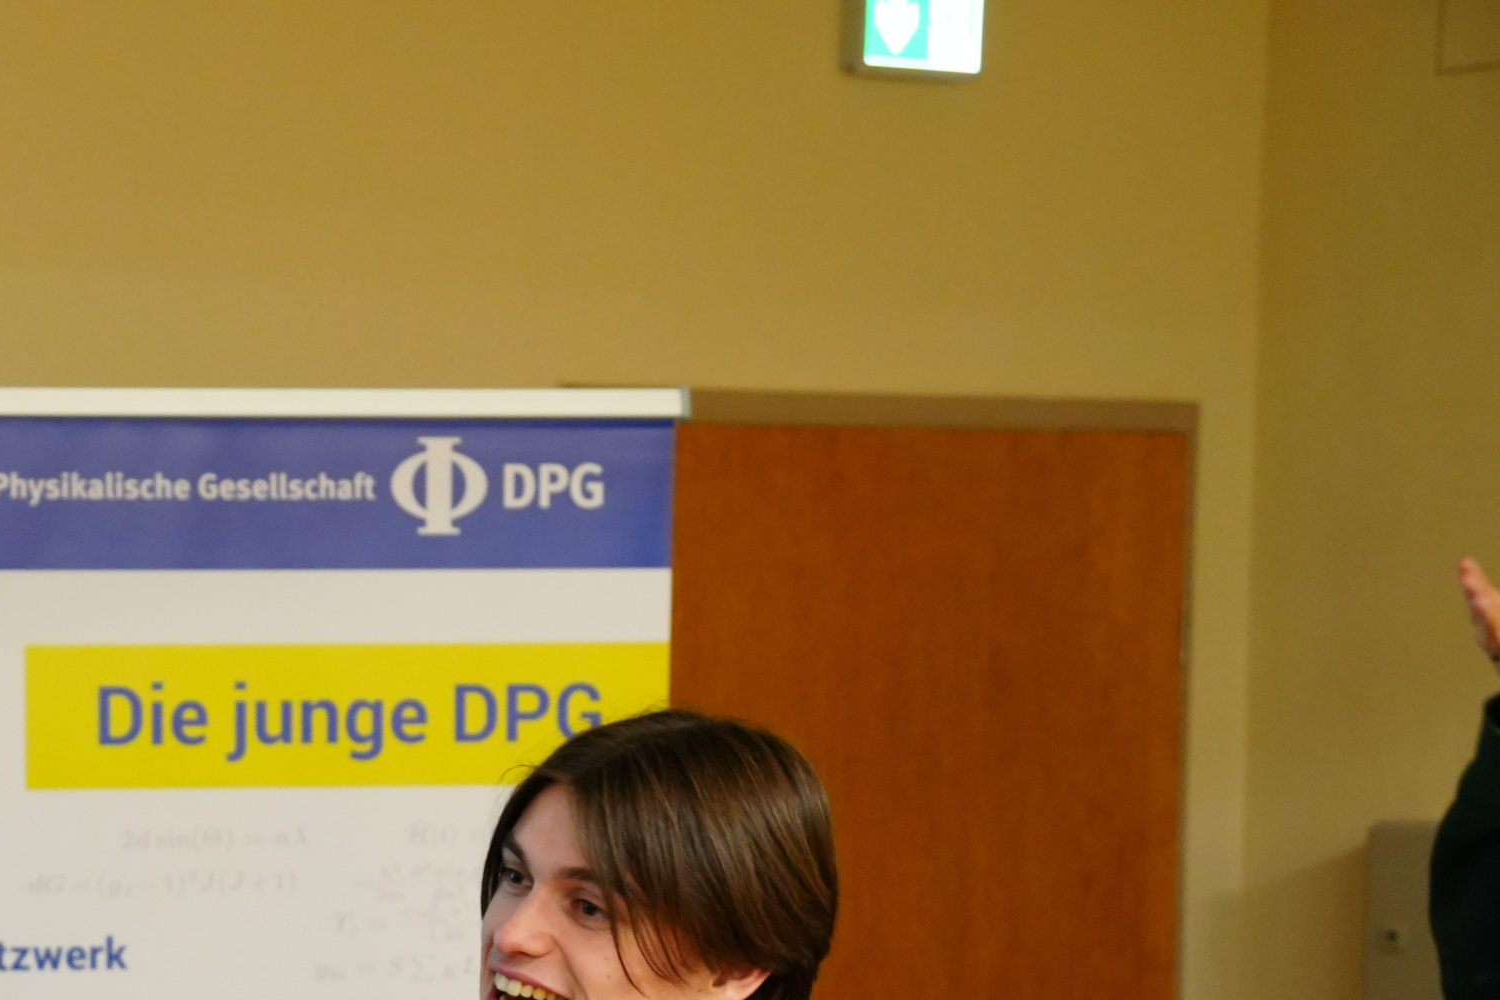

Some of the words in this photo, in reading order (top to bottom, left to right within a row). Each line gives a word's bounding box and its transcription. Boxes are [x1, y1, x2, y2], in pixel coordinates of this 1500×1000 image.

[197, 468, 376, 503] Gesellschaft
[501, 462, 606, 511] DPG
[96, 680, 210, 747] Die
[226, 680, 430, 762] junge
[453, 680, 603, 743] DPG
